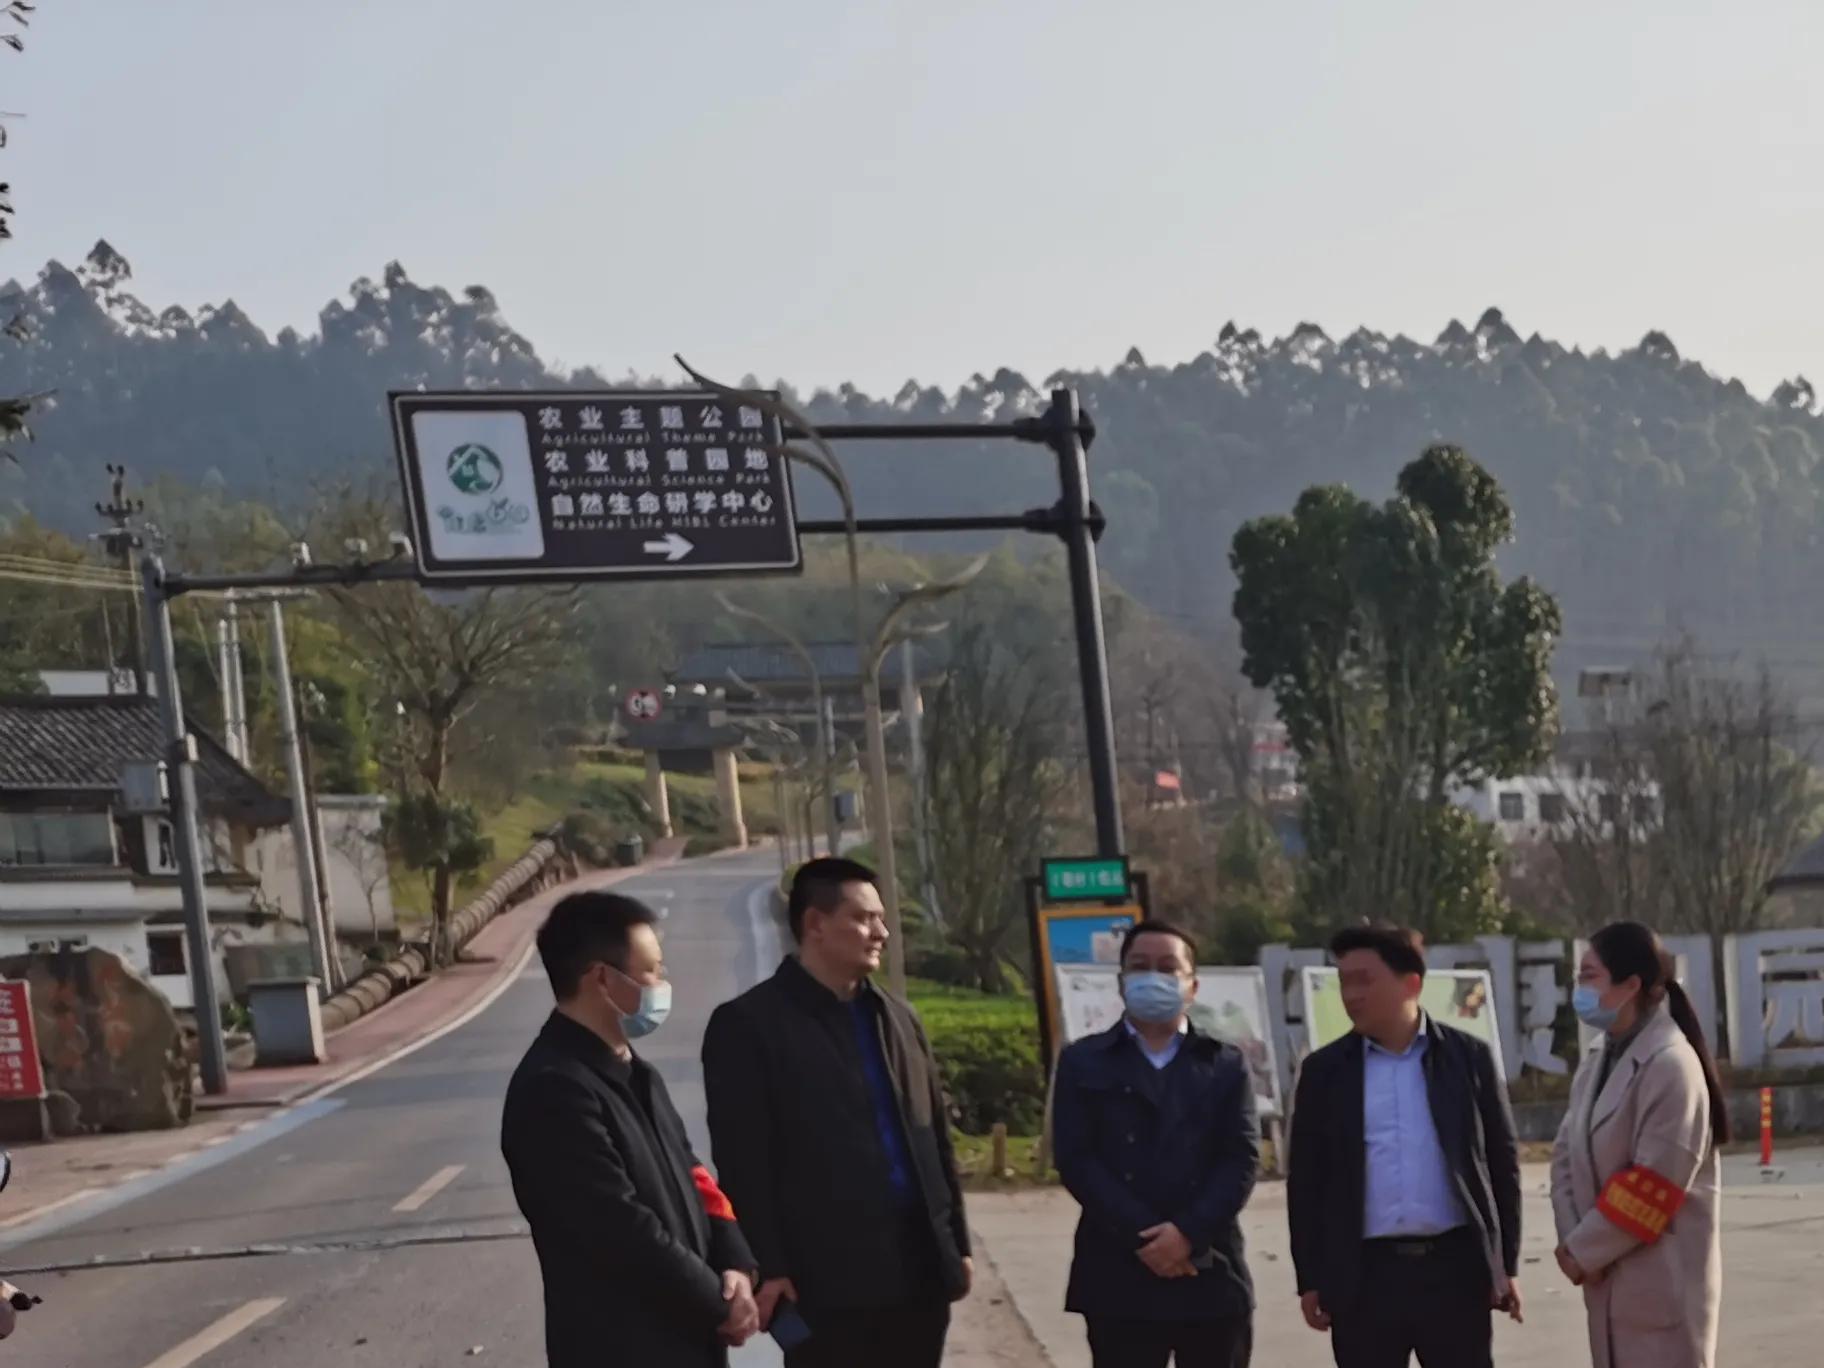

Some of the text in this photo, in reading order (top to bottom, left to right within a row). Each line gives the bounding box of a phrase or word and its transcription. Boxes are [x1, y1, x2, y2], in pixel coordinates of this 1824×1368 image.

[538, 405, 763, 429] 农业主题公园
[541, 432, 650, 447] Agricultural
[728, 430, 763, 443] Park
[547, 472, 771, 490] Agricultural Science Park
[551, 489, 774, 516] 自然生命研学中心
[553, 517, 622, 530] Natural
[630, 516, 663, 529] Life
[719, 514, 776, 527] Center
